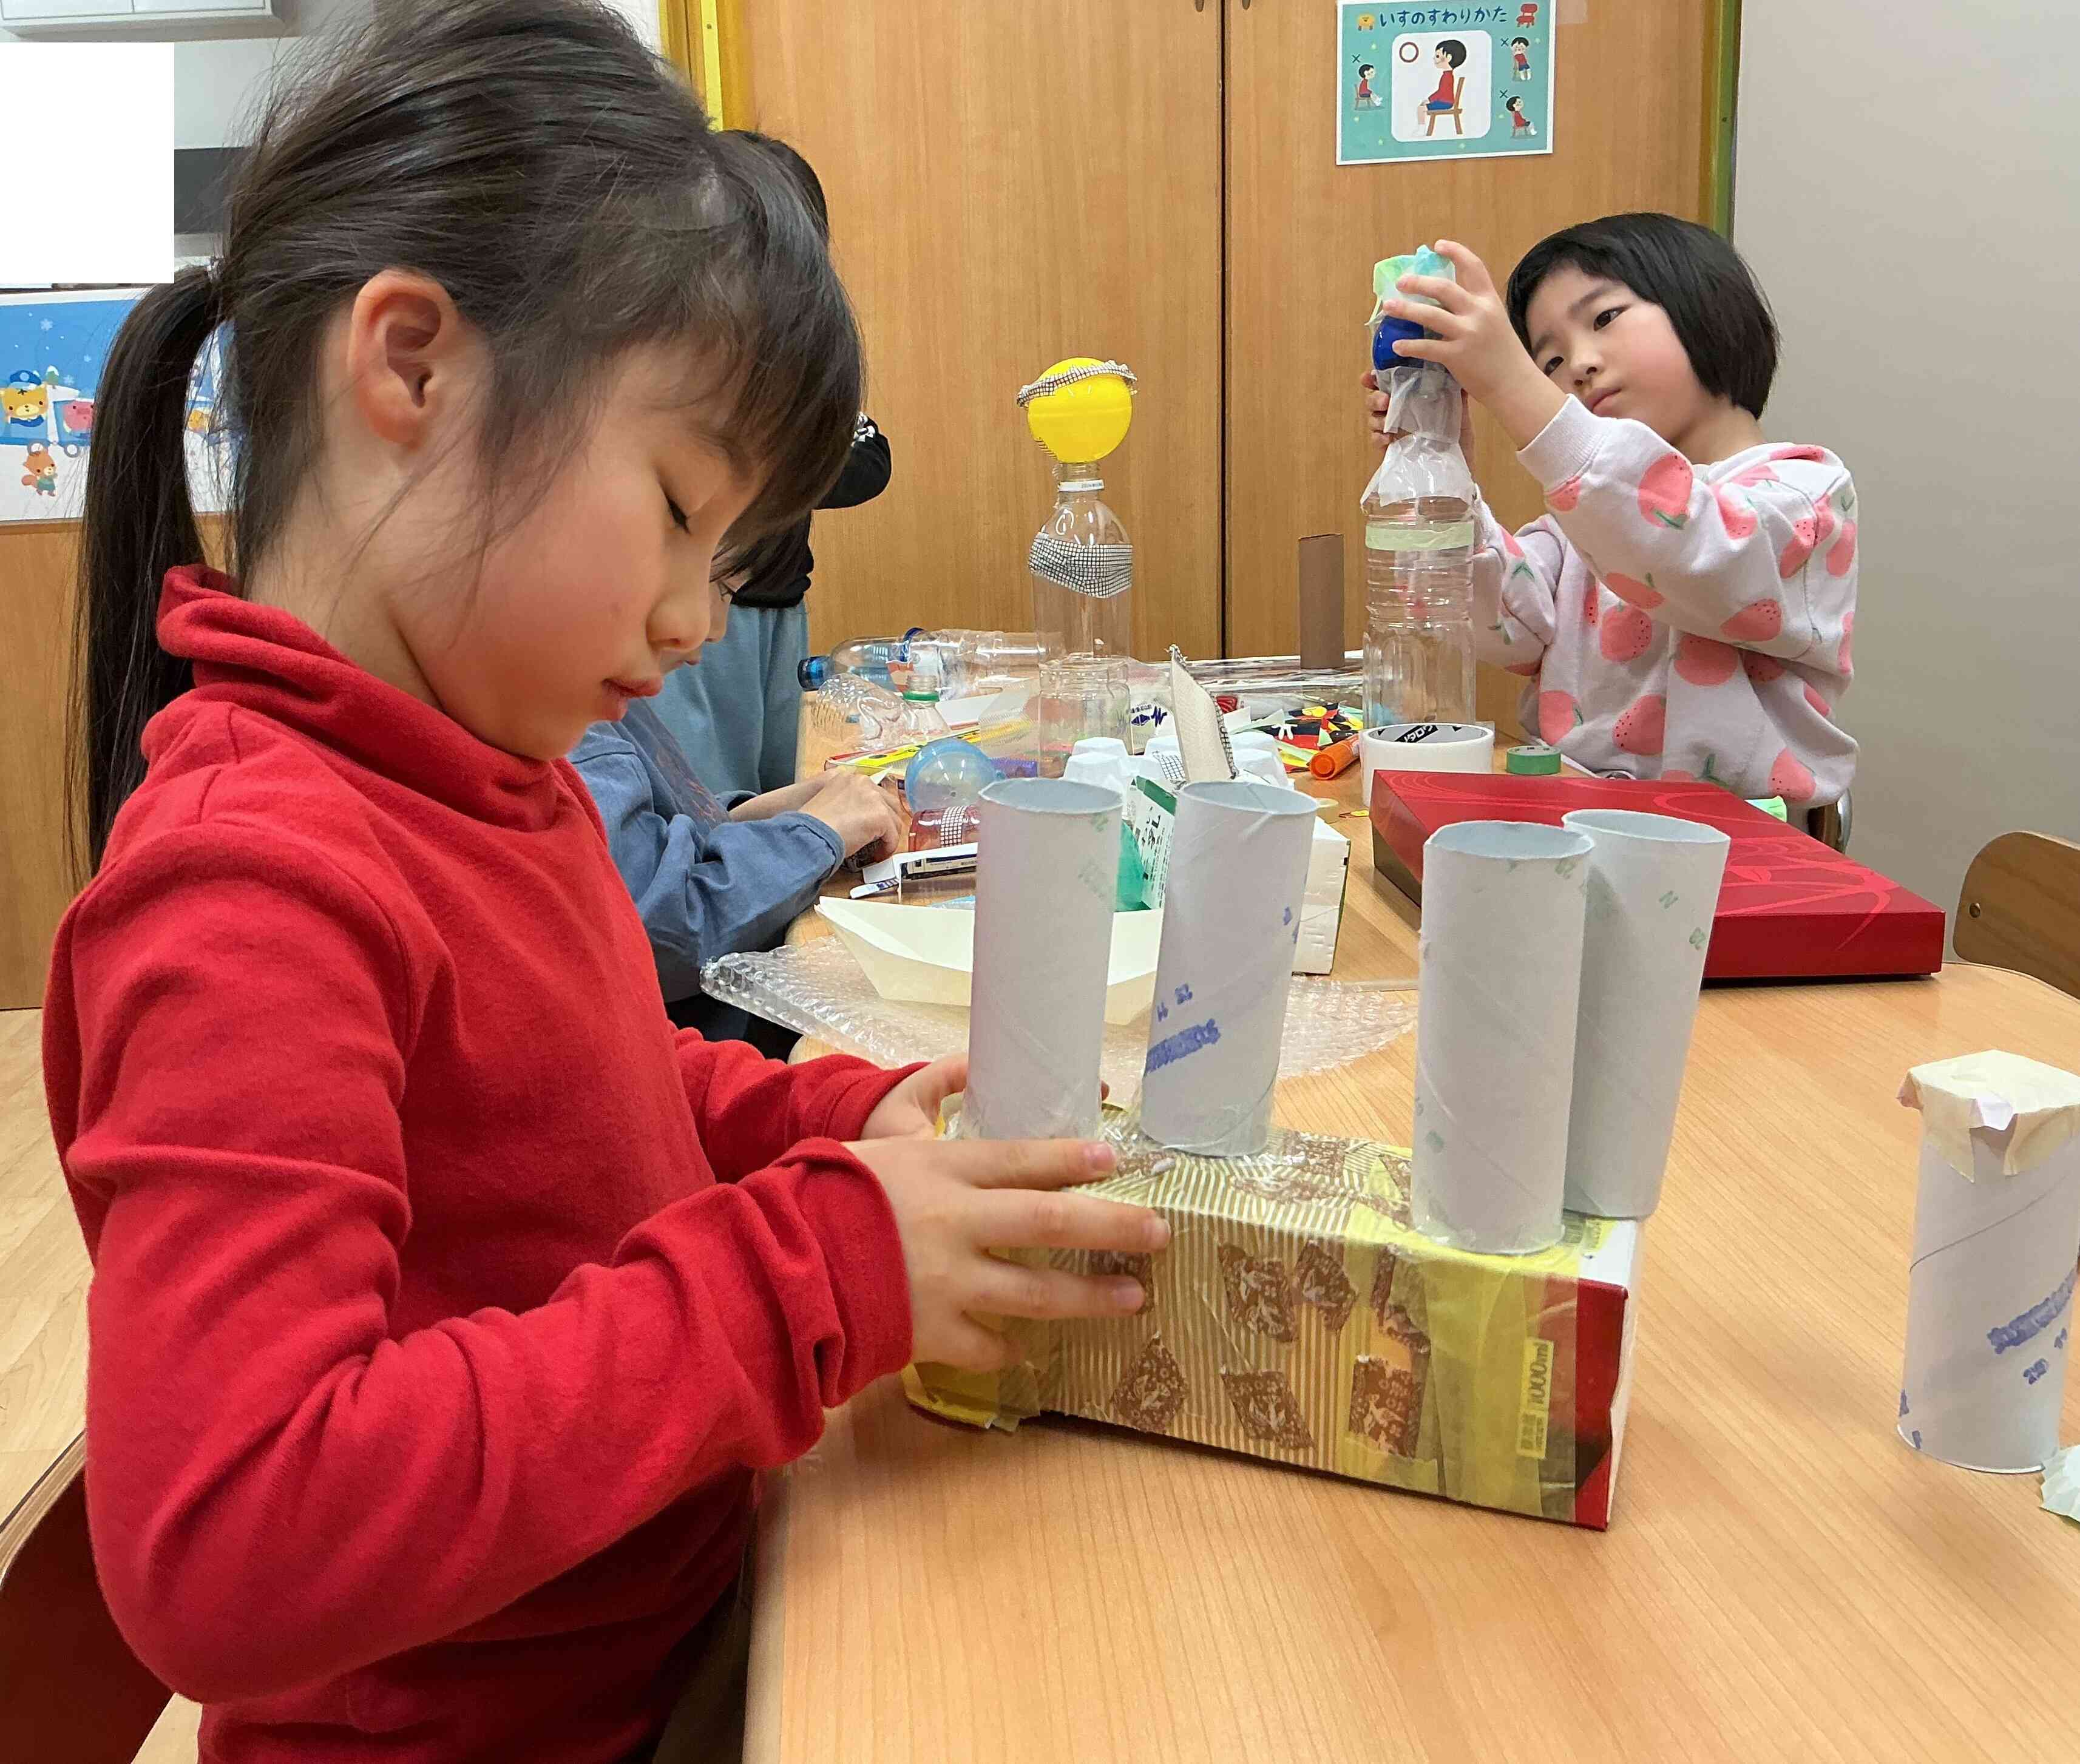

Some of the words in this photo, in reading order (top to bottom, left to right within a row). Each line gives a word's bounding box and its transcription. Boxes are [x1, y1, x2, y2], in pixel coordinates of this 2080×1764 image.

[1380, 5, 1507, 27] いすのすわりかた
